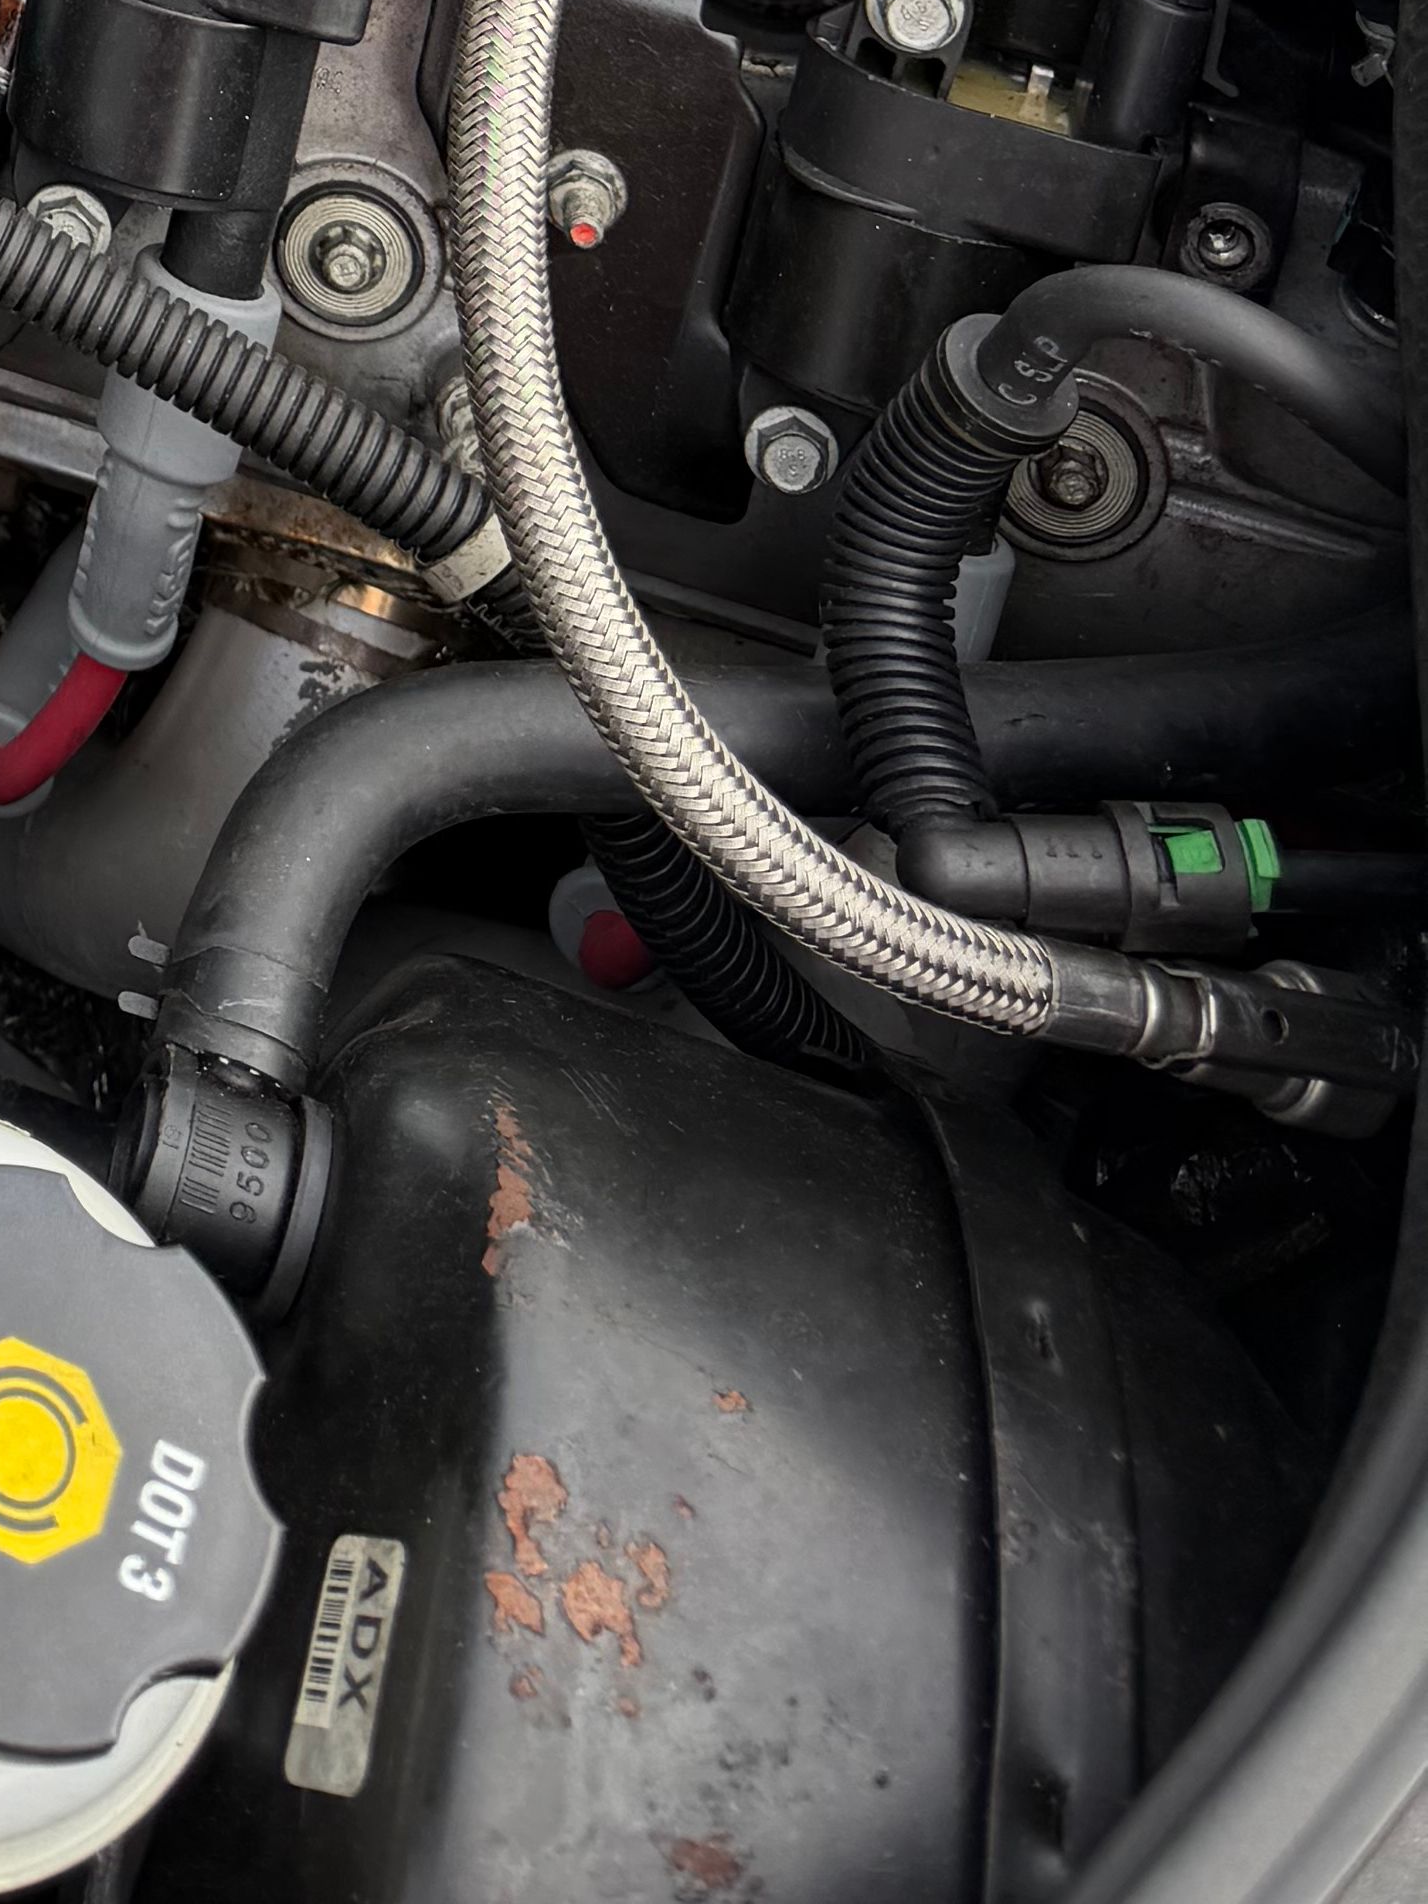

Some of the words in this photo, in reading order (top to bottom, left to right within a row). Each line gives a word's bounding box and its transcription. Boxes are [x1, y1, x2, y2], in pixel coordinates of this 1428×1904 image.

[1013, 335, 1069, 383] SLP
[227, 1119, 274, 1226] 9500
[131, 1437, 207, 1566] DOT
[117, 1550, 178, 1603] 3
[336, 1556, 390, 1711] ADX
